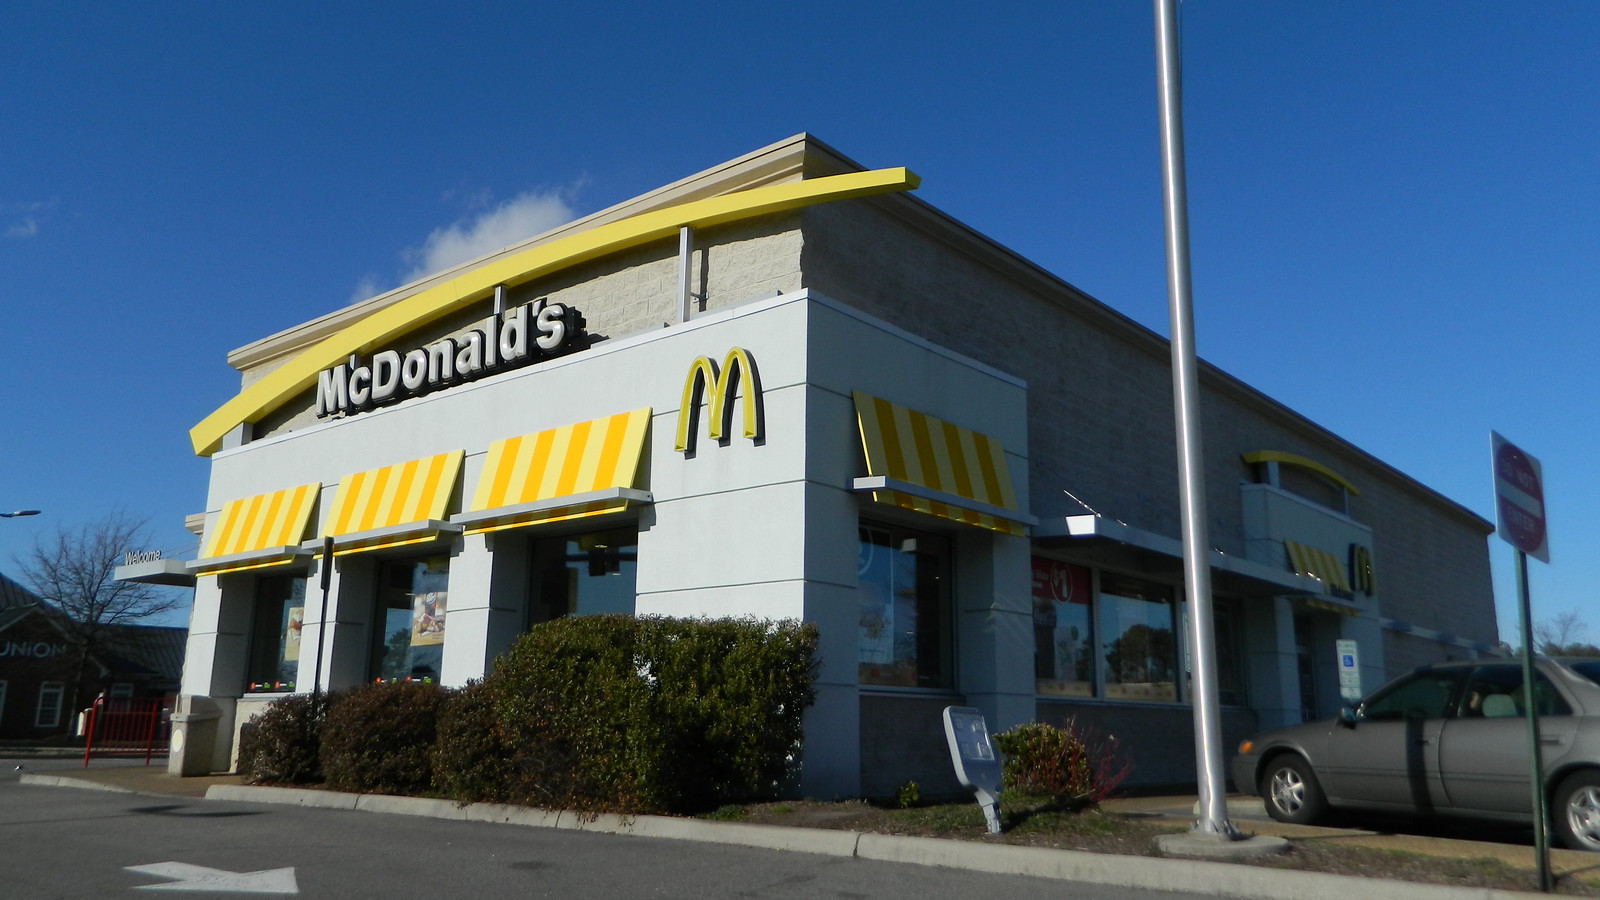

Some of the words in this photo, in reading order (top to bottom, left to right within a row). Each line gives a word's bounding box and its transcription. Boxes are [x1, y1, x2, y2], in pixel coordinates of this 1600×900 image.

[315, 297, 566, 417] McDonald's
[125, 550, 161, 566] Welcome
[1052, 567, 1068, 598] $1
